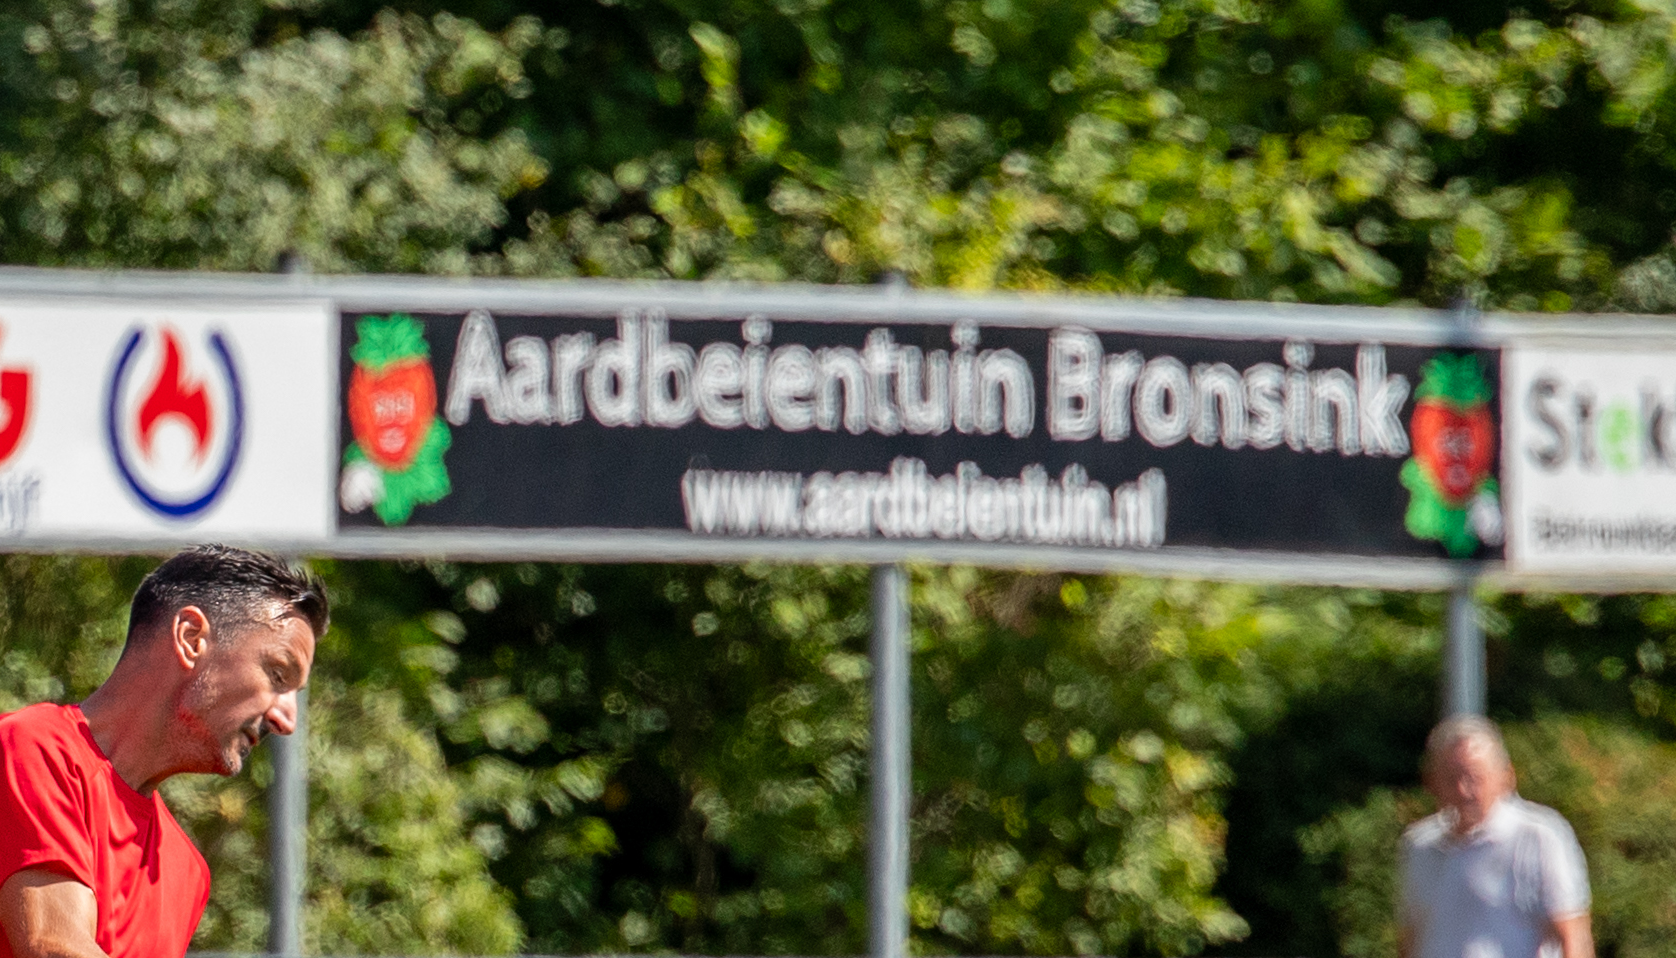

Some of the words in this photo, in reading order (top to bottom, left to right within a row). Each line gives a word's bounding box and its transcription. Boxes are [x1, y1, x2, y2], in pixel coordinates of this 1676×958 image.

[445, 308, 1035, 438] Aardbeientuin
[1046, 326, 1411, 457] Bronsink
[682, 456, 1167, 548] www.aardbeientuin.nl
